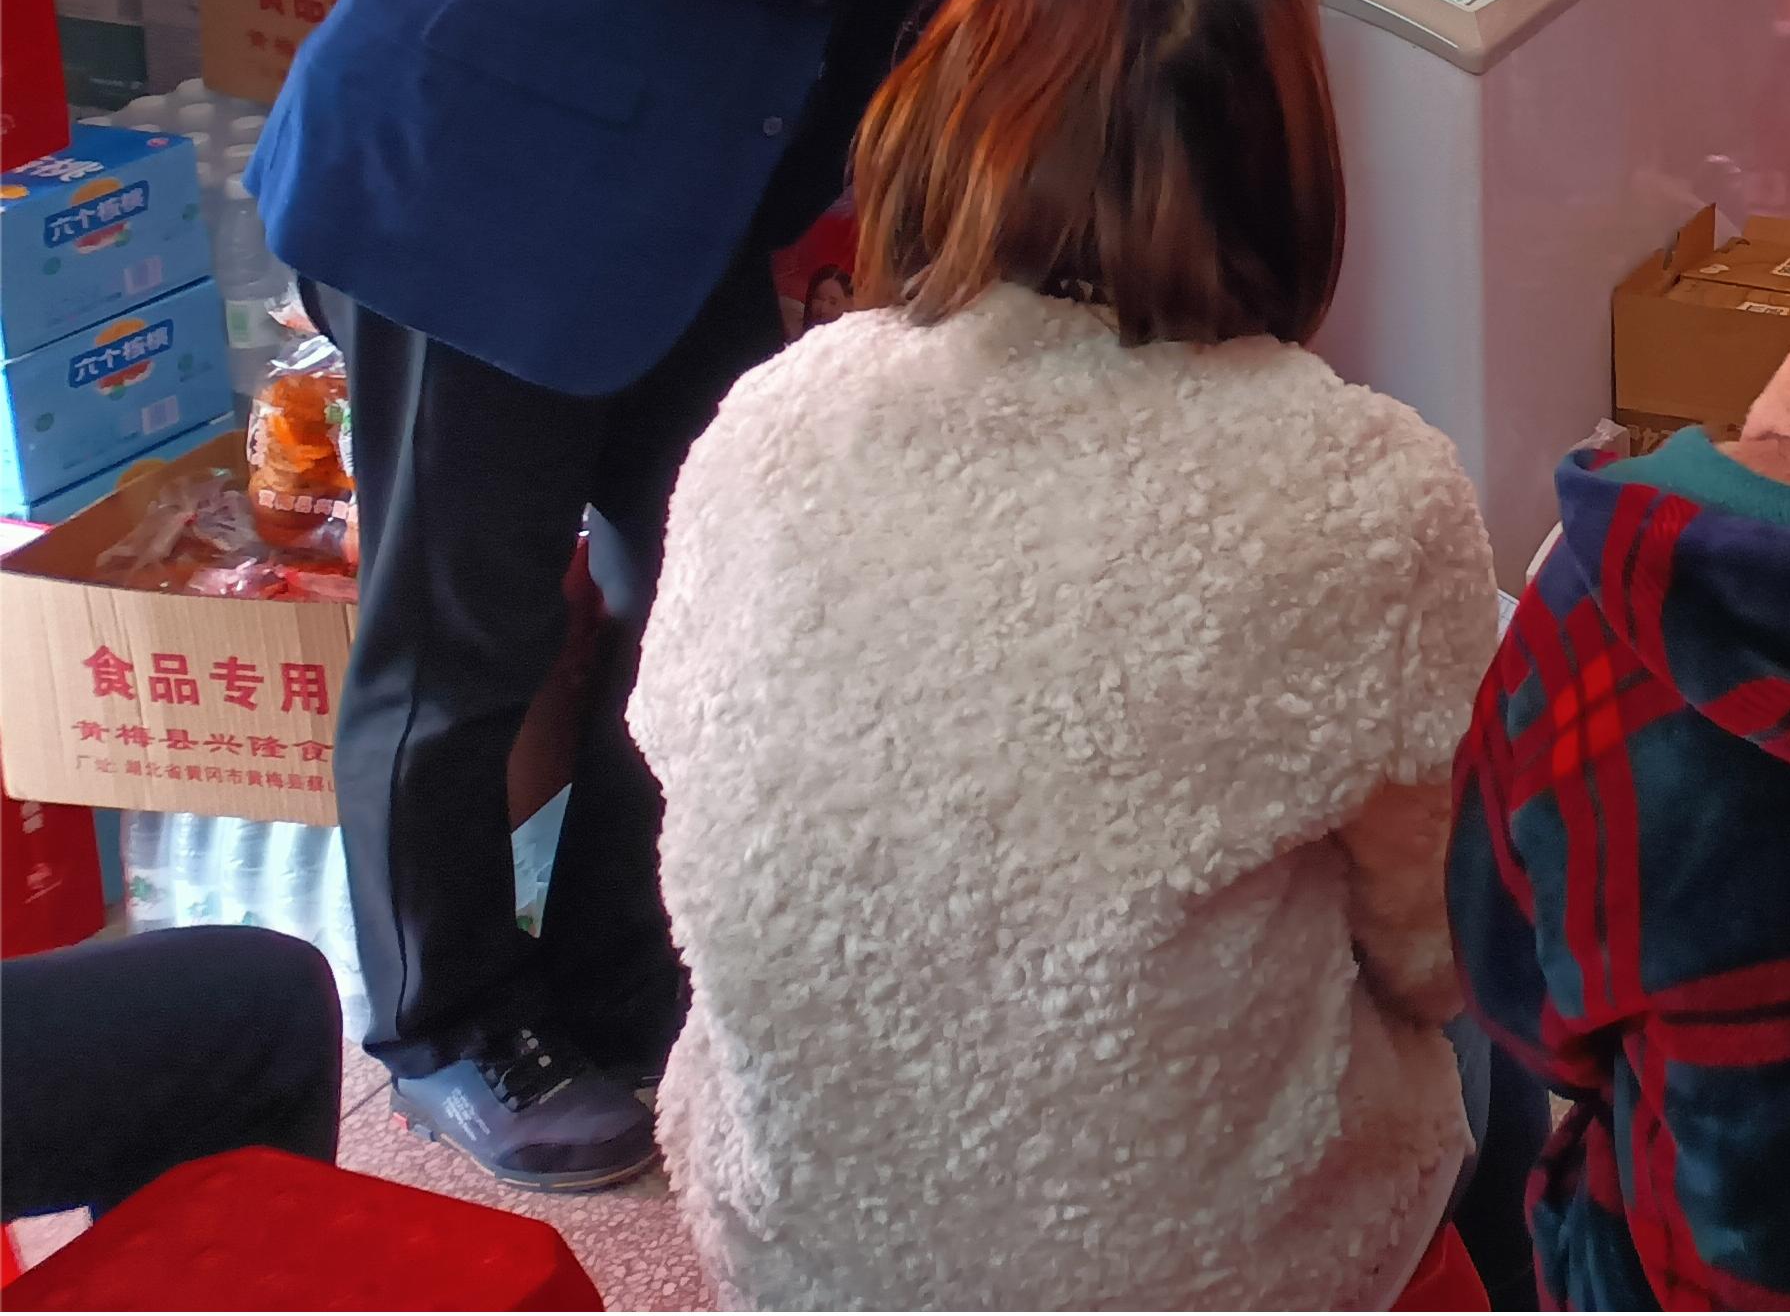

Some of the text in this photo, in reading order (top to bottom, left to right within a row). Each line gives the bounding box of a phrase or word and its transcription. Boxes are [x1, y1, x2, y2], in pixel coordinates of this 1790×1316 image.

[82, 644, 330, 715] 食品专用
[71, 719, 335, 763] 黄梅县兴隆食
